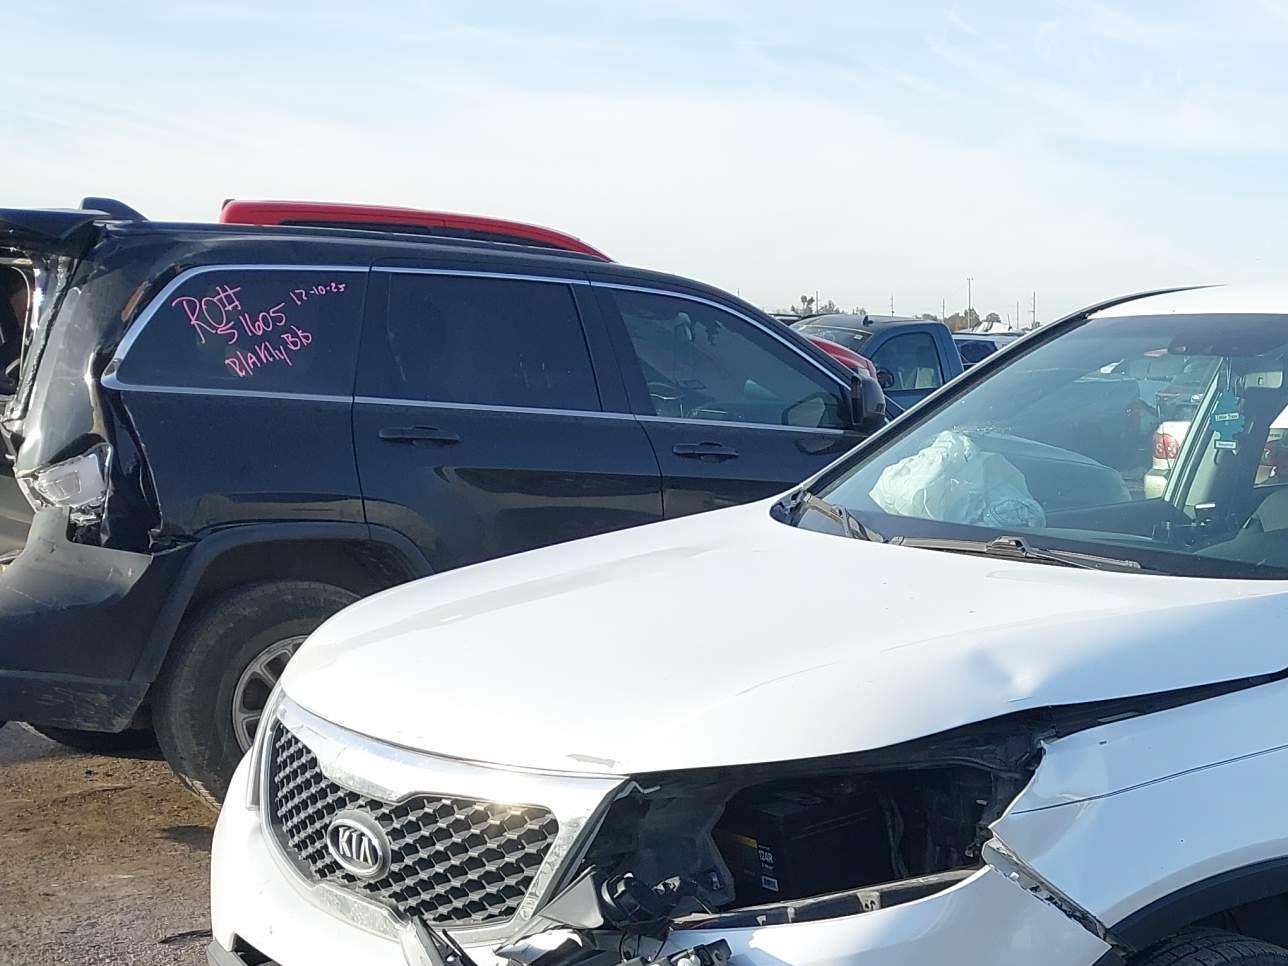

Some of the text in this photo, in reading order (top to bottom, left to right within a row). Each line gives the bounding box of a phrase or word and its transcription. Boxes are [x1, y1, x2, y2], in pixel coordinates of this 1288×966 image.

[172, 285, 241, 343] RO#
[217, 303, 286, 344] 51605
[338, 826, 373, 867] KIA
